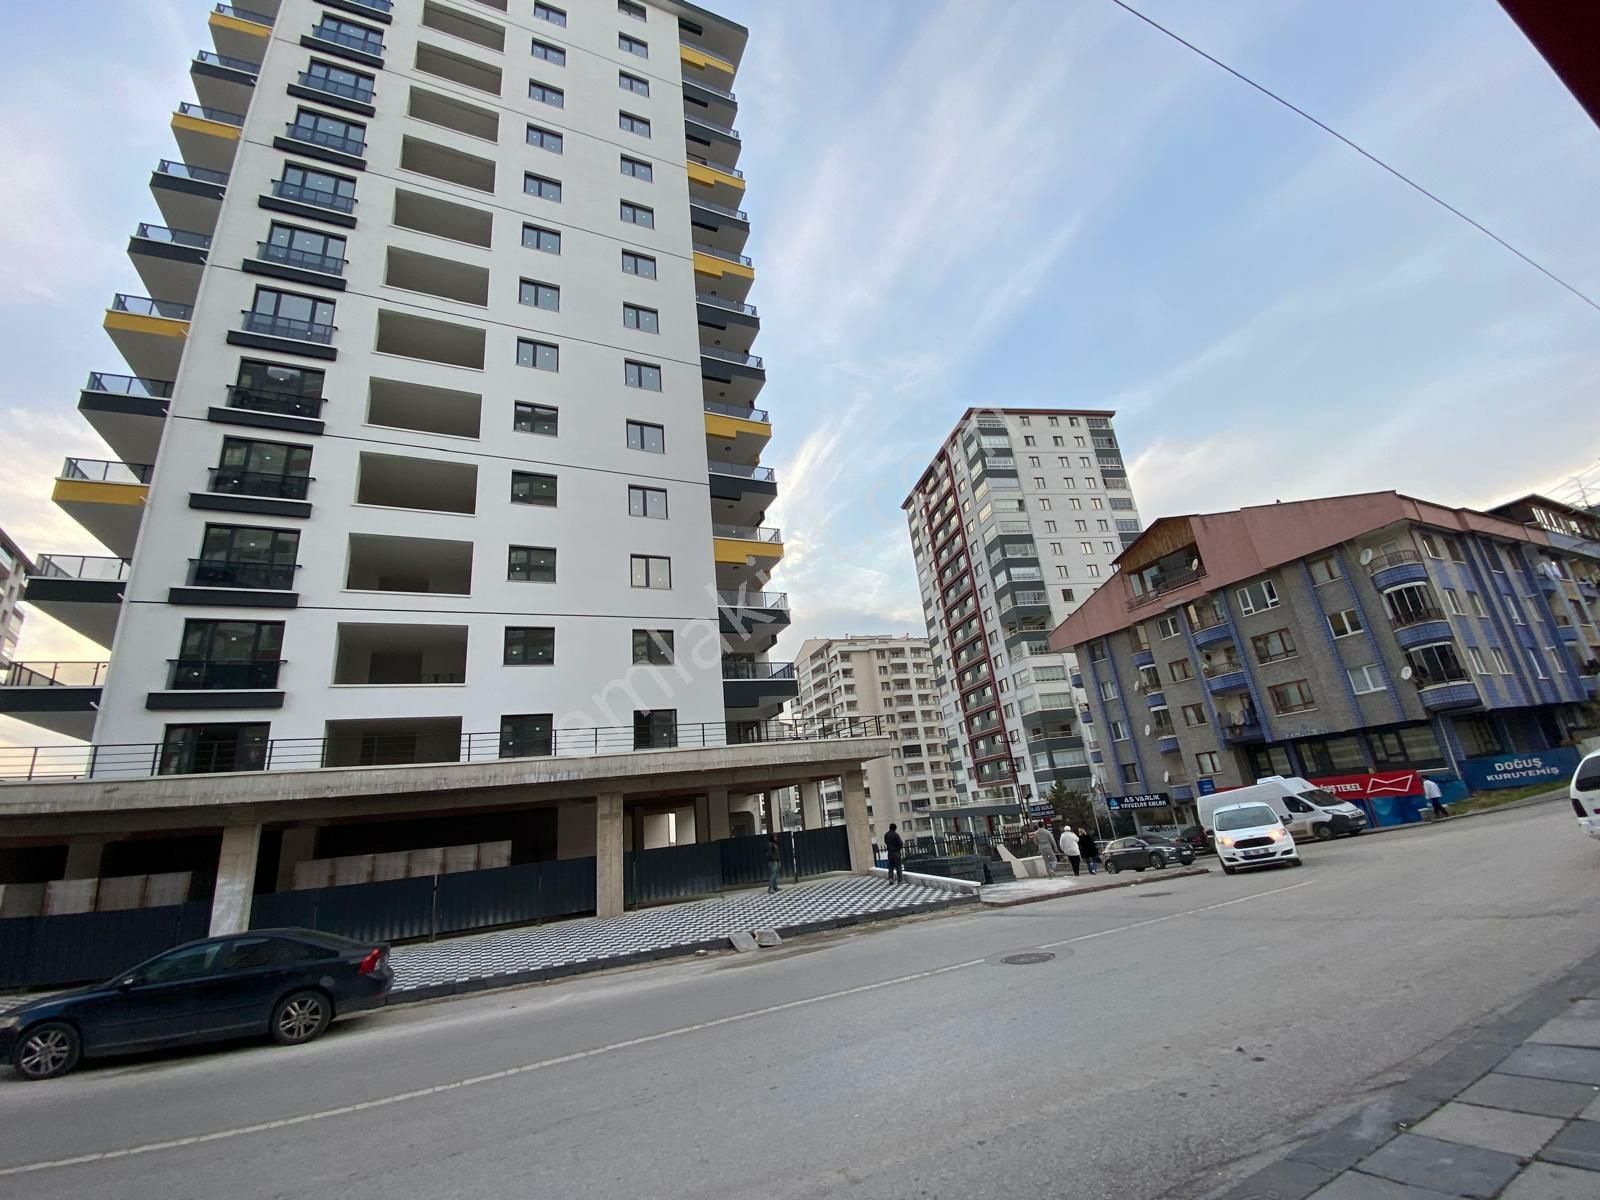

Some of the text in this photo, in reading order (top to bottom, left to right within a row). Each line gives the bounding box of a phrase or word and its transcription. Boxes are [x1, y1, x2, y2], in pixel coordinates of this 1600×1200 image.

[1494, 757, 1542, 772] DOĞUŞ
[1486, 766, 1559, 781] KURUYEMİŞ
[1319, 783, 1363, 795] ĞUŞ TEKEL
[1134, 794, 1160, 802] VARLIK
